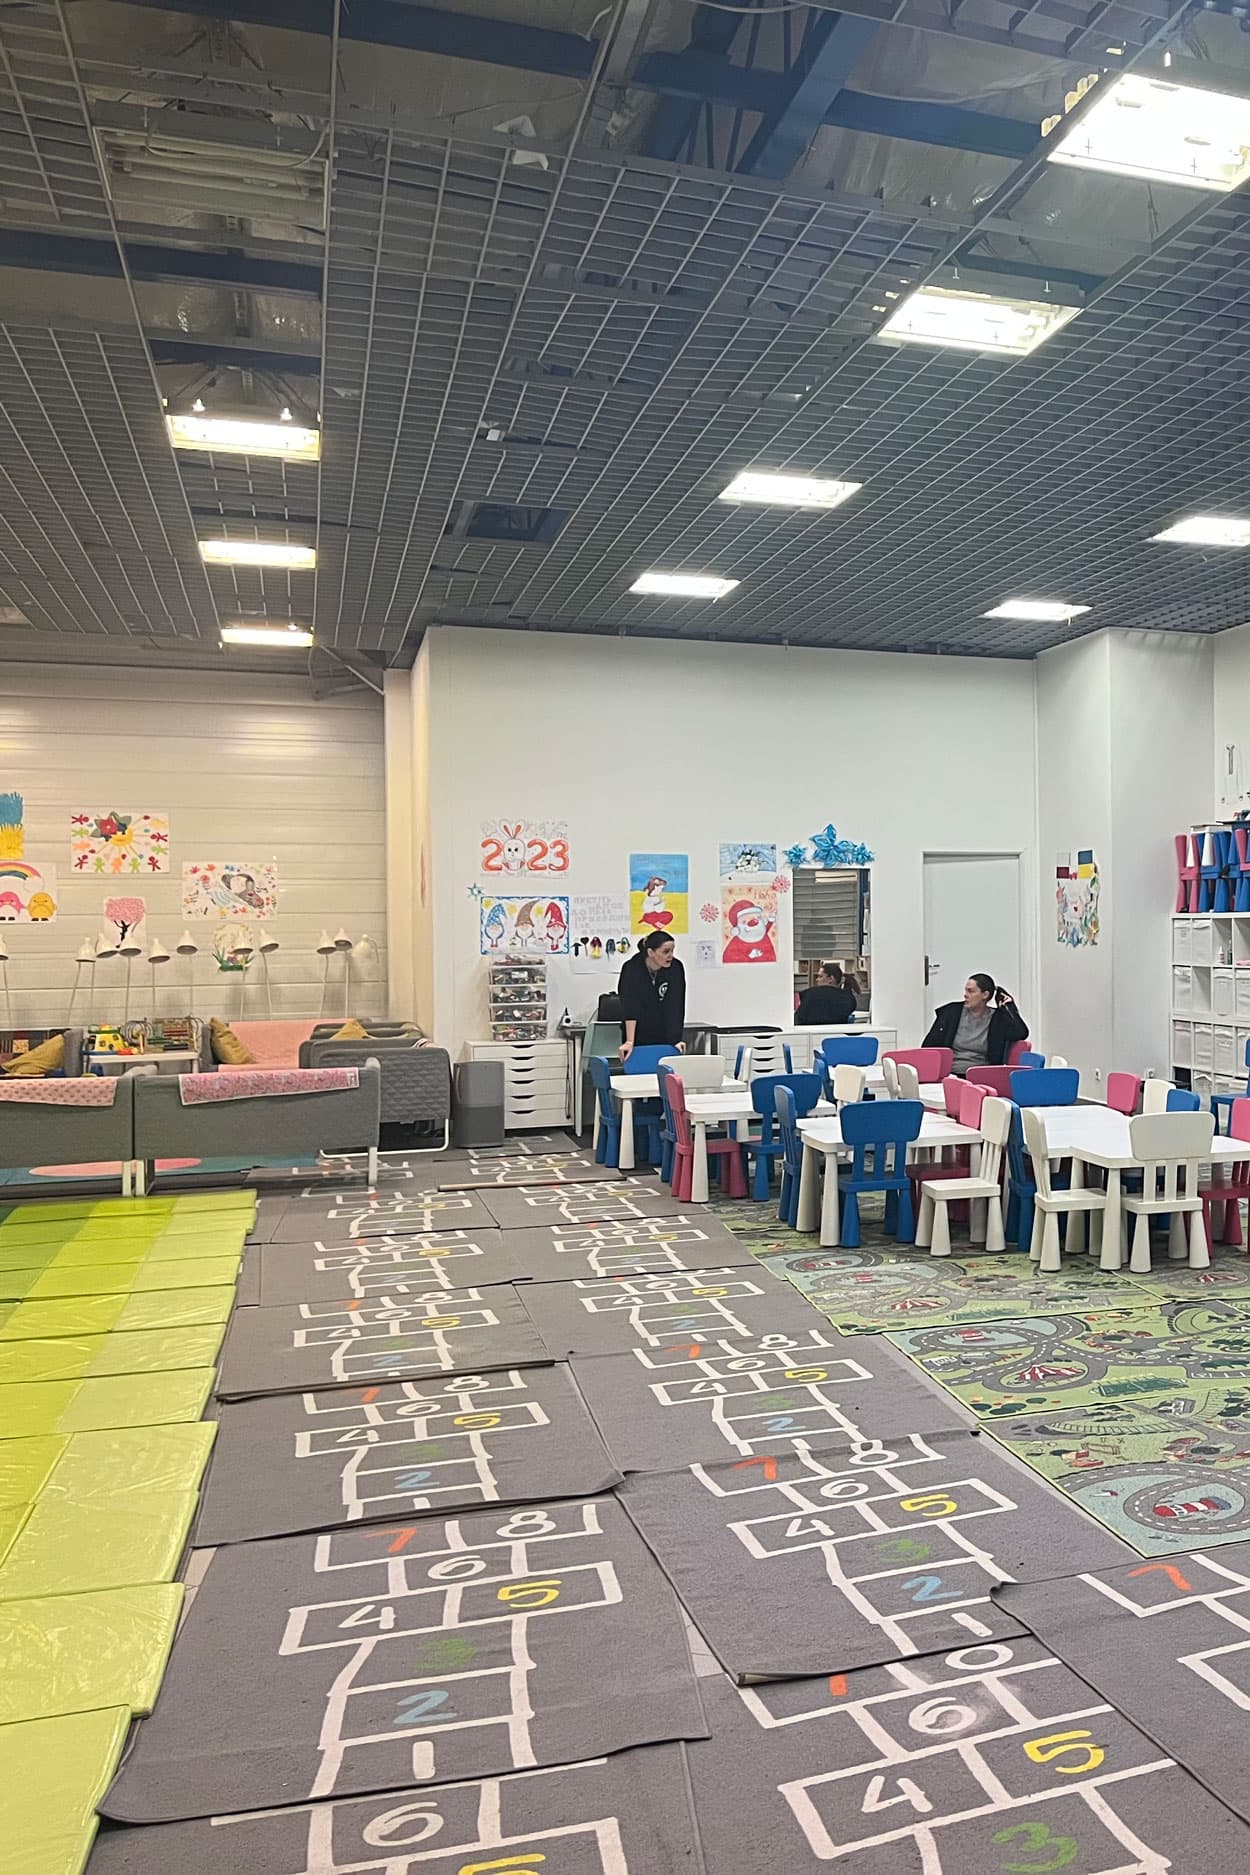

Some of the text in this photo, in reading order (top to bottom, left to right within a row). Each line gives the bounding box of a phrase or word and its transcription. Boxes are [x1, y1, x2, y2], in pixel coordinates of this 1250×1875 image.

[757, 1334, 798, 1350] 8
[727, 1357, 766, 1371] 6
[444, 1376, 490, 1392] 8
[689, 1368, 828, 1394] 4 5
[396, 1400, 441, 1416] 6
[336, 1413, 501, 1443] 4 5
[762, 1417, 807, 1432] 2
[730, 1440, 899, 1481] 7 8
[394, 1470, 440, 1489] 2
[820, 1479, 869, 1499] 6
[785, 1494, 958, 1537] 4 5
[364, 1510, 557, 1553] 7 8
[427, 1555, 487, 1580] 6
[1127, 1564, 1192, 1591] 7
[901, 1575, 964, 1601] 2
[338, 1580, 562, 1630] 4 5
[392, 1690, 458, 1724] 2
[908, 1697, 977, 1735] 6
[412, 1740, 435, 1779] 1
[861, 1730, 1105, 1813] 4 5
[362, 1801, 444, 1847] 6
[992, 1822, 1080, 1873] 3
